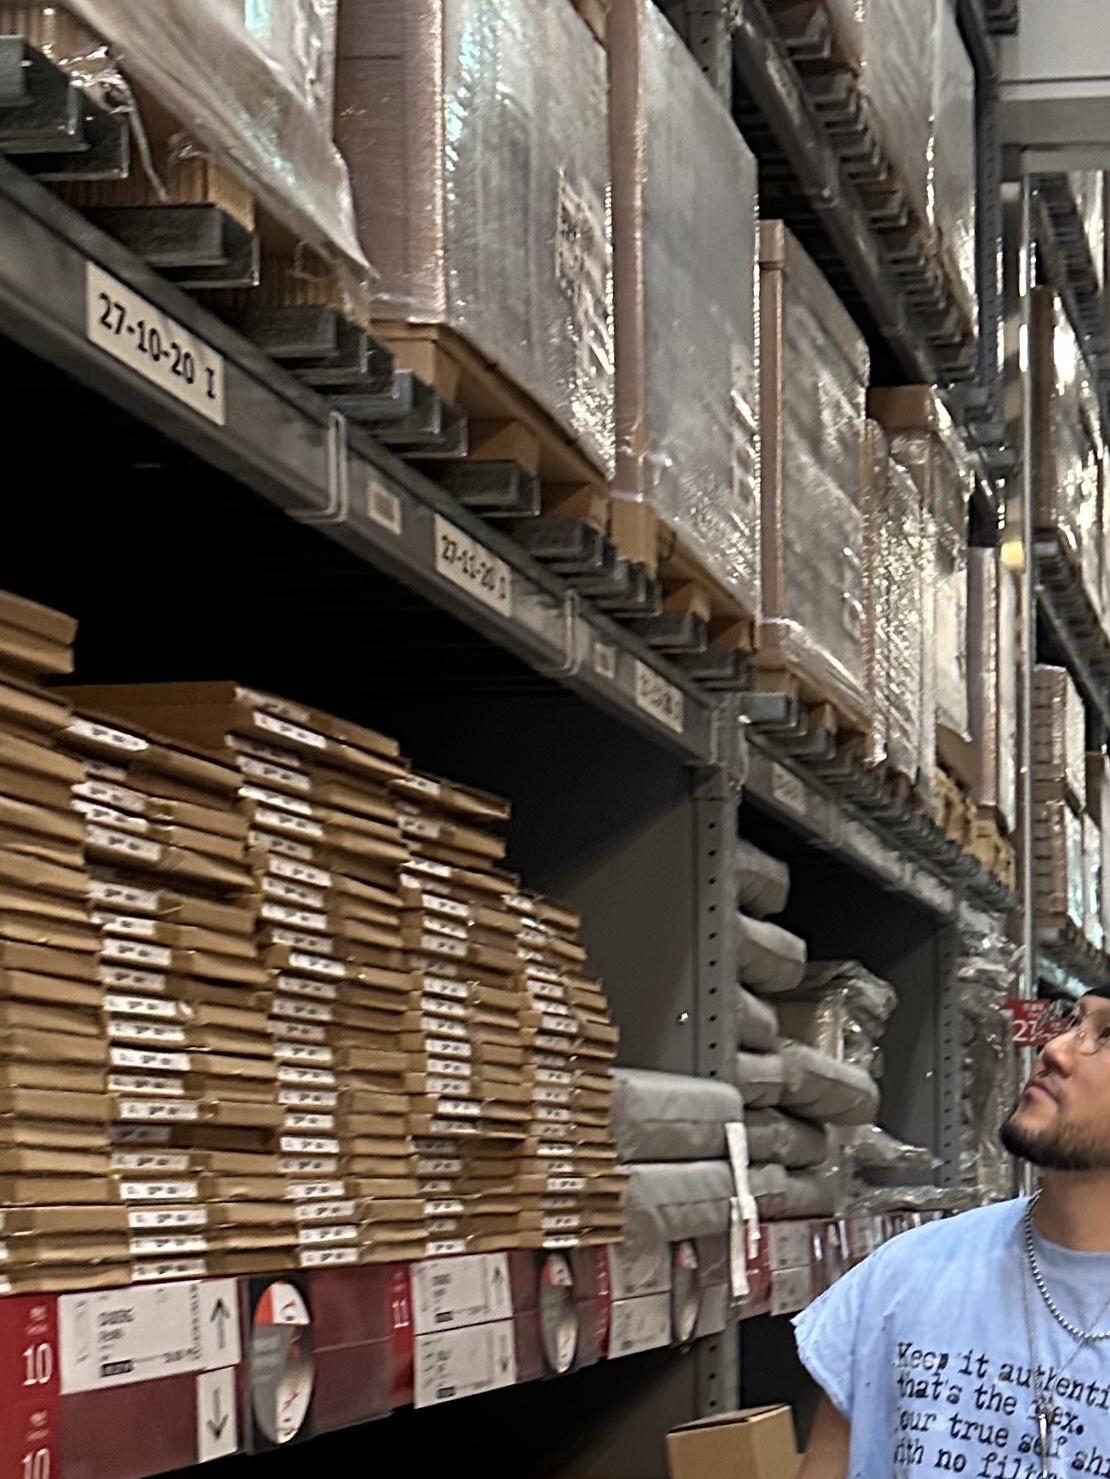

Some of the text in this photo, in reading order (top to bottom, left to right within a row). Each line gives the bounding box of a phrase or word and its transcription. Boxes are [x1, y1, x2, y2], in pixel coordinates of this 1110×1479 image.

[99, 292, 195, 385] 27-10-20
[22, 1342, 53, 1387] 10
[958, 1349, 989, 1379] it
[974, 1383, 1018, 1416] the
[949, 1412, 1010, 1448] true
[1017, 1433, 1069, 1458] sef
[933, 1448, 967, 1473] no
